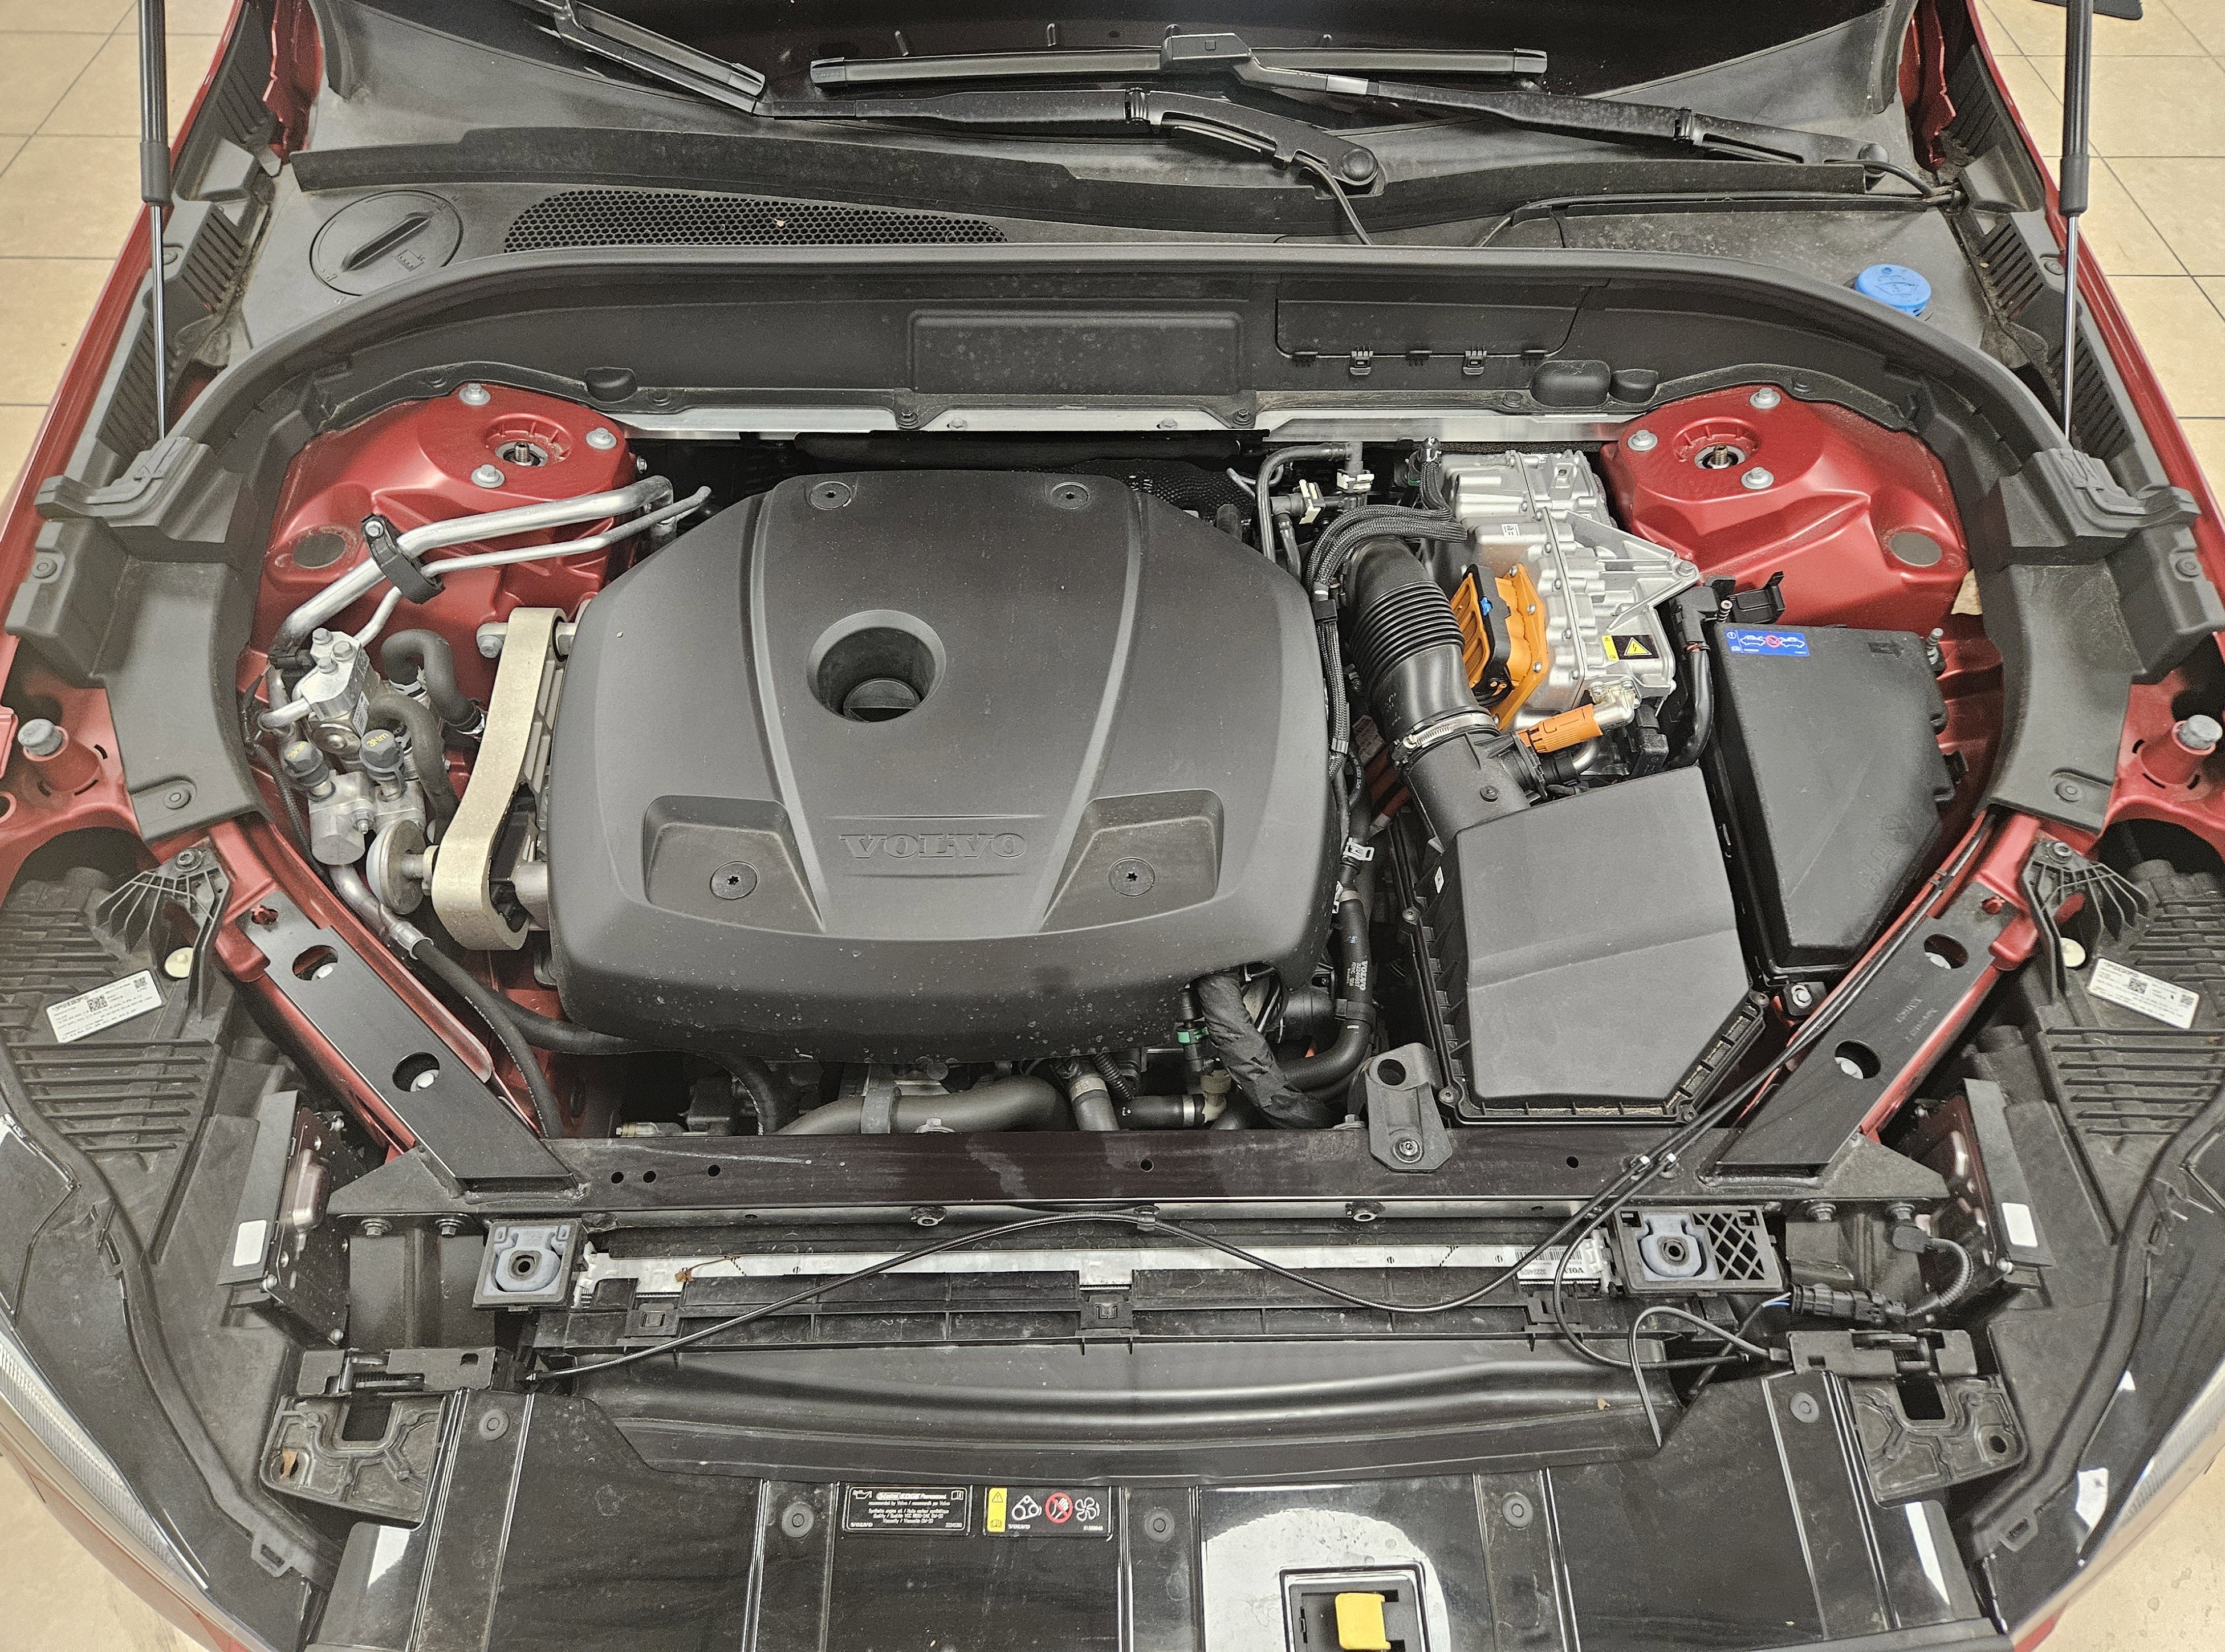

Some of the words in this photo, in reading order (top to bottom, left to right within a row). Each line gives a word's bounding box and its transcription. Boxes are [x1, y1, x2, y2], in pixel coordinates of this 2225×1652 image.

[366, 733, 389, 747] 3Nm
[839, 833, 1026, 858] VOLVO
[1360, 961, 1368, 991] VOLVO
